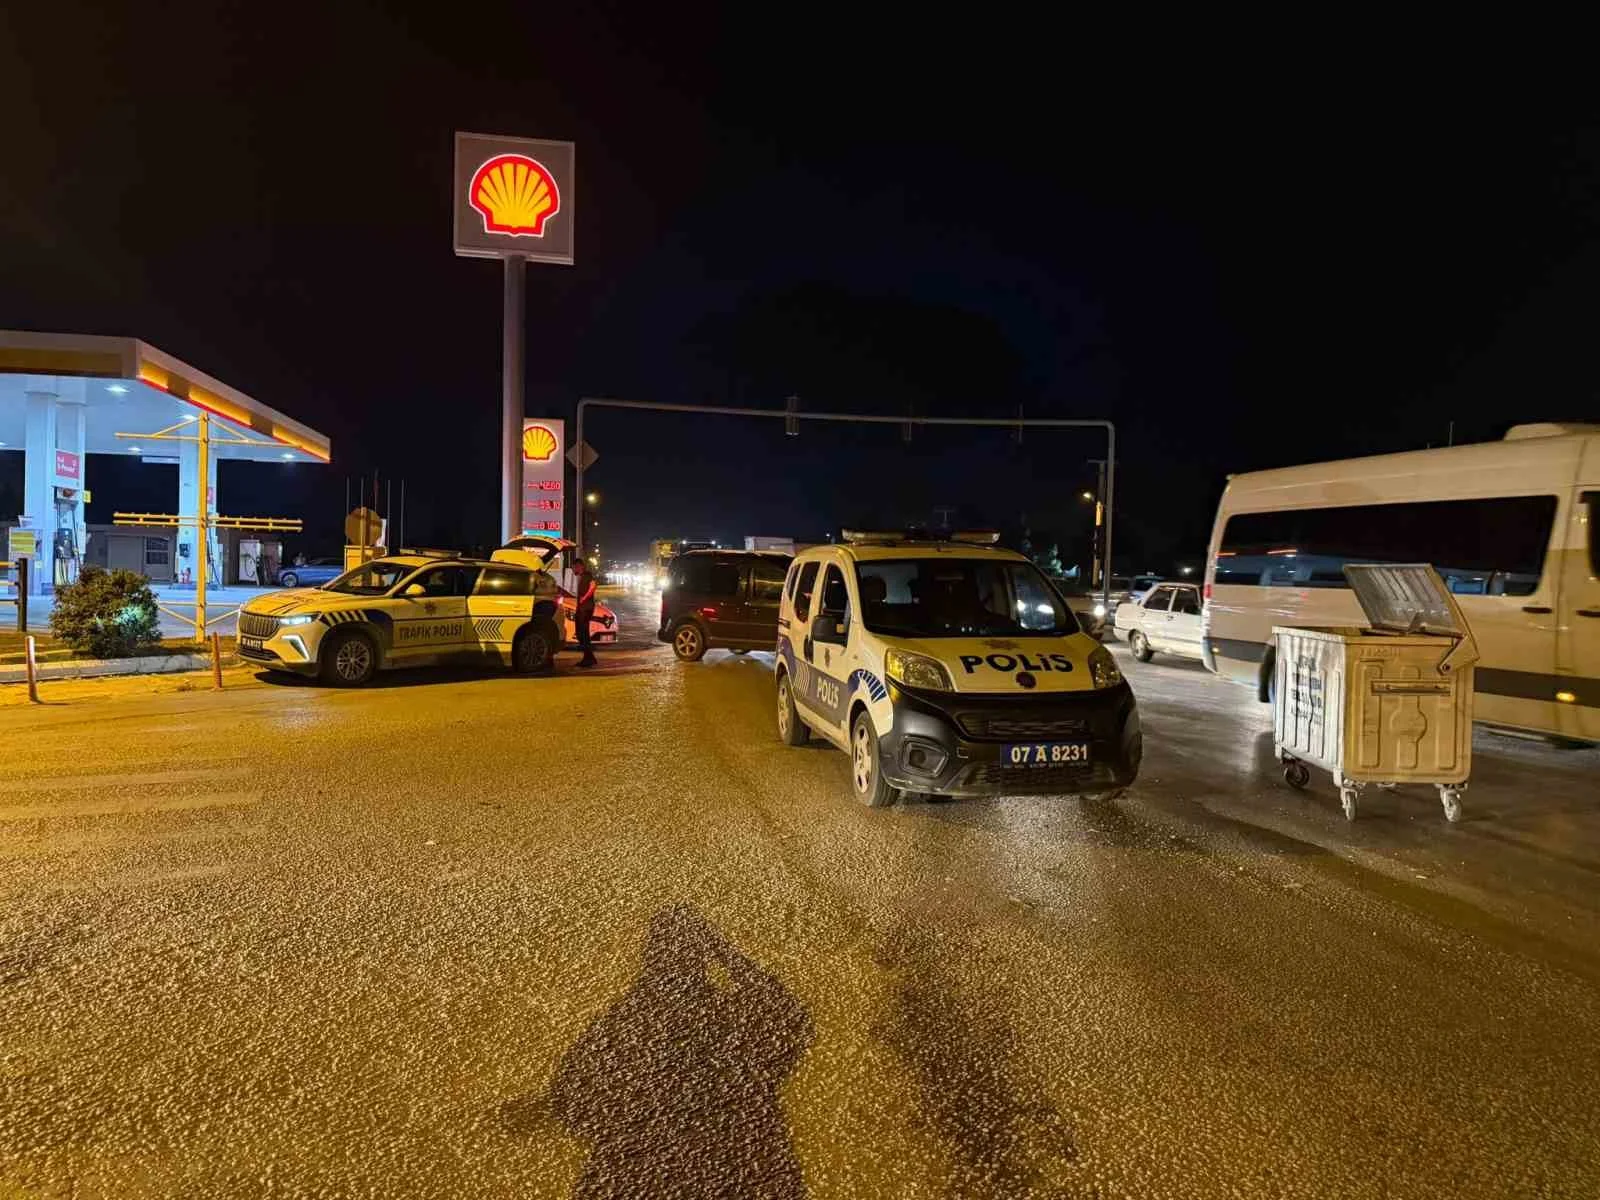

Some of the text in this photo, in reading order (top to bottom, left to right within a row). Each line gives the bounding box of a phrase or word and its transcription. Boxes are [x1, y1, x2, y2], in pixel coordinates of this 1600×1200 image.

[1011, 744, 1088, 763] 07 A 8231
